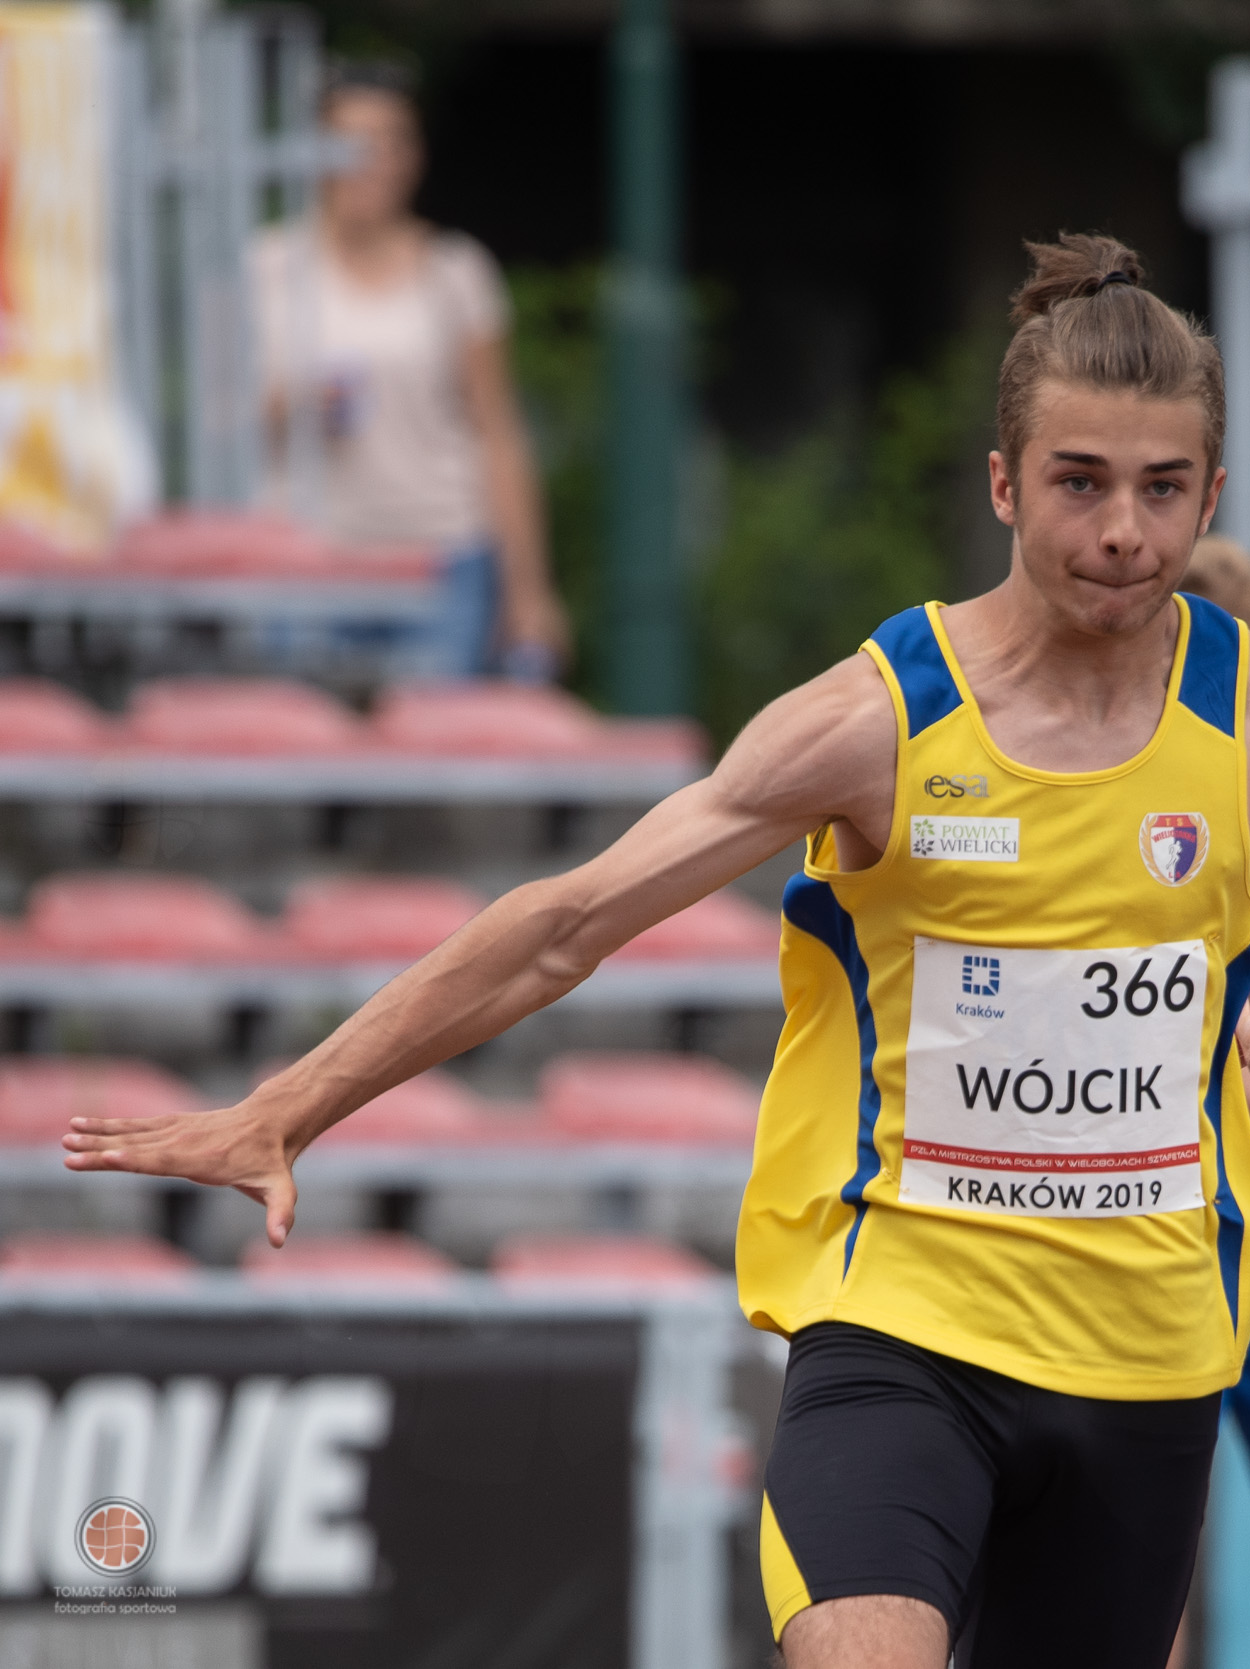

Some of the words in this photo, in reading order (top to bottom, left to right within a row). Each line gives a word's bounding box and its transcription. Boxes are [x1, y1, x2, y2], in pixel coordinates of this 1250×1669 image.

[924, 774, 991, 799] esa
[941, 824, 1011, 840] POWIAT
[939, 838, 1017, 854] WIELICKI
[1080, 953, 1195, 1019] 366
[955, 1002, 1005, 1019] Kraków
[956, 1058, 1163, 1115] WÓJCIK
[910, 1144, 938, 1157] PZLA
[938, 1150, 1012, 1166] MISTRZOSTWA
[1014, 1159, 1052, 1168] POLSKI
[1055, 1160, 1066, 1168] W
[1068, 1158, 1142, 1168] WIELOBOJACH
[1147, 1149, 1198, 1165] SZTAFETACH
[948, 1176, 1086, 1210] KRAKÓW
[1096, 1180, 1163, 1209] 2019
